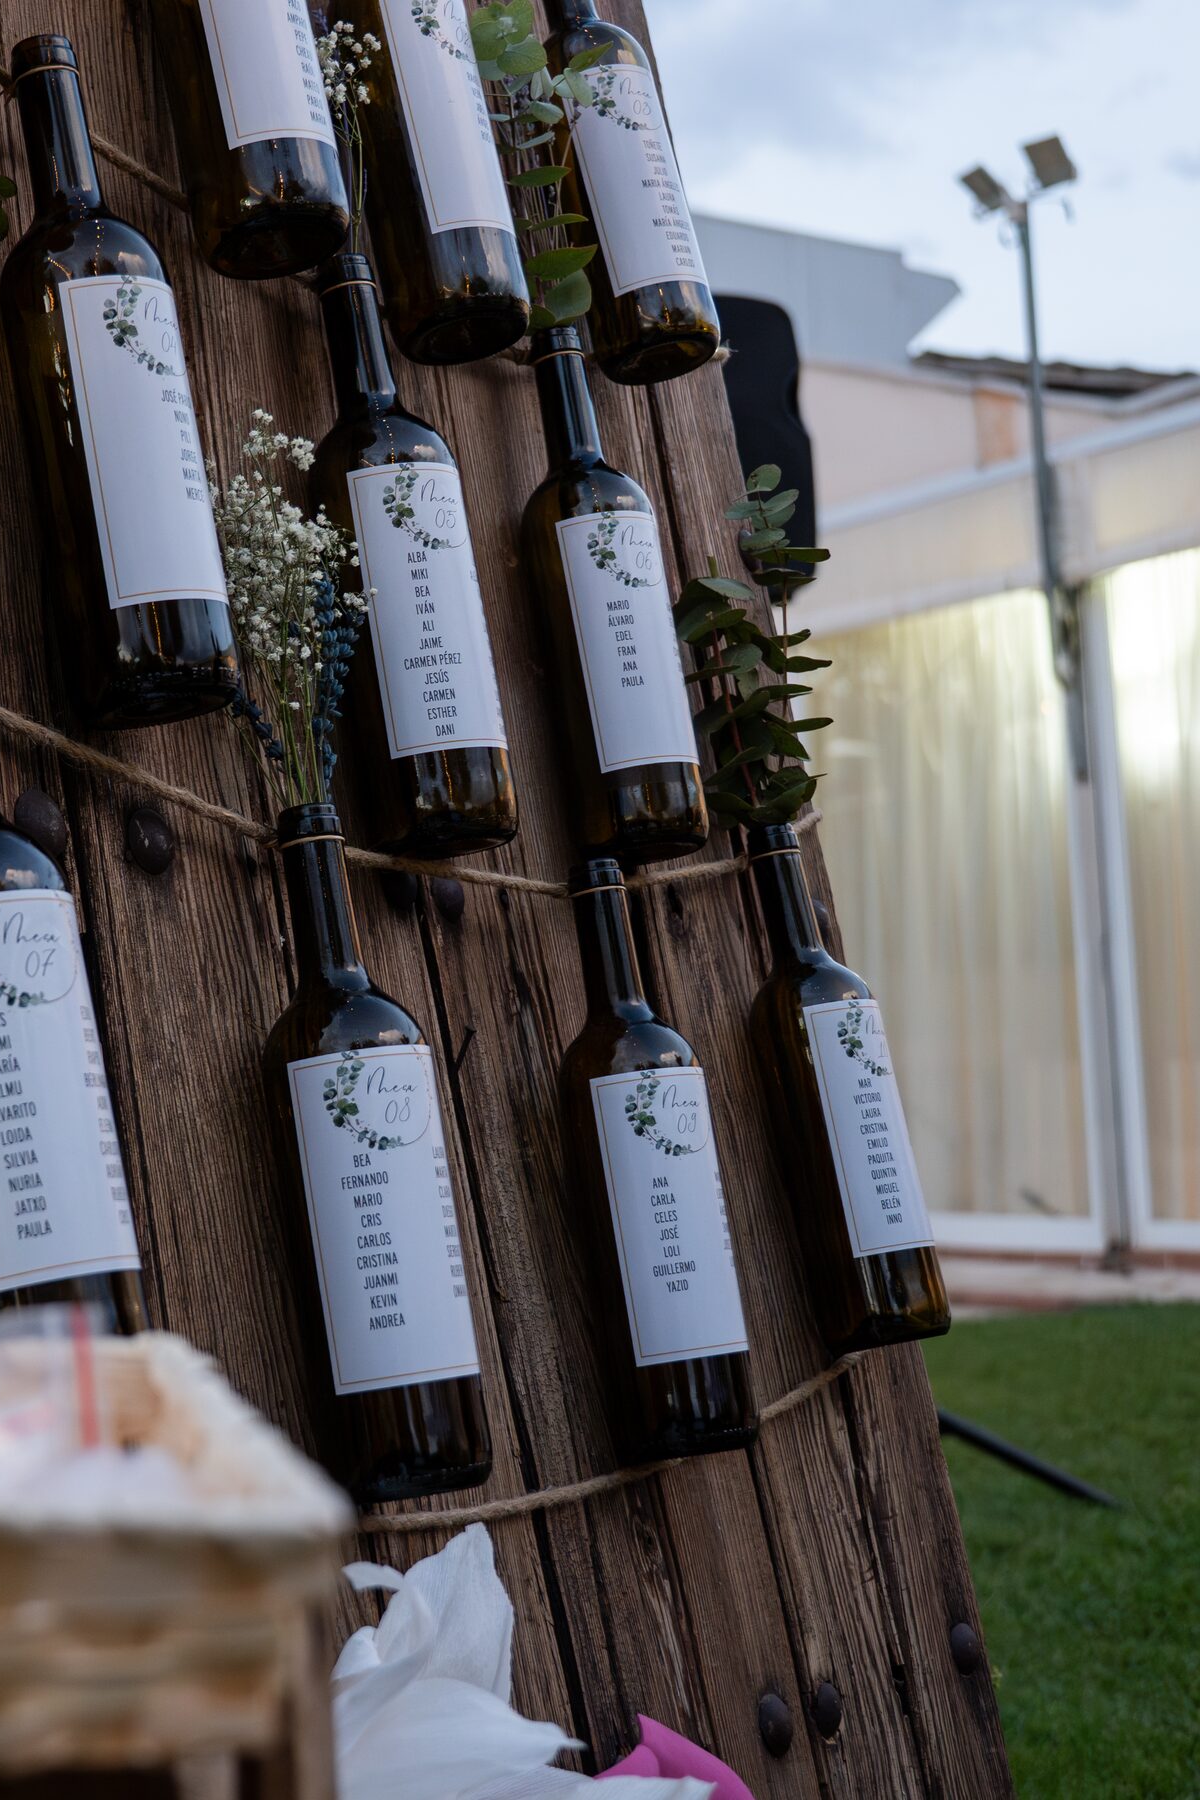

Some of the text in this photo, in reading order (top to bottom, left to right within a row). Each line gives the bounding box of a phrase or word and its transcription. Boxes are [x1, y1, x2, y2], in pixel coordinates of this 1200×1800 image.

[161, 388, 178, 402] JOSÉ
[420, 479, 459, 505] Mesa
[435, 509, 457, 529] 05
[407, 551, 427, 564] ALBA
[635, 551, 652, 570] 06
[411, 568, 428, 580] MIKI
[415, 585, 430, 598] BEA
[416, 601, 435, 615] IVÁN
[606, 600, 630, 612] MARIO
[422, 620, 434, 632] ALI
[608, 614, 634, 628] ÁLVARO
[615, 630, 633, 641] EDEL
[419, 637, 443, 650] JAIME
[617, 644, 637, 657] FRAN
[404, 651, 462, 670] CARMEN PÉREZ
[622, 661, 638, 672] ANA
[424, 669, 449, 685] JESÚS
[621, 676, 644, 688] PAULA
[423, 688, 456, 703] CARMEN
[427, 706, 457, 720] ESTHER
[435, 723, 455, 737] DANI
[2, 911, 60, 945] Mesa
[25, 948, 57, 979] 07
[366, 1066, 418, 1095] Mesa
[858, 1078, 872, 1088] MAR
[662, 1084, 700, 1109] Mesa
[853, 1092, 882, 1105] VICTORIO
[385, 1098, 411, 1124] 08
[861, 1108, 881, 1120] LAURA
[677, 1113, 697, 1134] 09
[860, 1122, 889, 1135] CRISTINA
[0, 1129, 33, 1146] LOIDA
[867, 1137, 889, 1150] EMILIO
[3, 1150, 38, 1170] SILVIA
[353, 1153, 371, 1168] BEA
[868, 1152, 894, 1165] PAQUITA
[8, 1172, 43, 1193] NURIA
[341, 1172, 389, 1190] FERNANDO
[652, 1176, 669, 1189] ANA
[876, 1183, 900, 1195] MIGUEL
[14, 1196, 47, 1217] JATXO
[353, 1191, 383, 1208] MARIO
[650, 1193, 676, 1206] CARLA
[881, 1195, 901, 1210] BELÉN
[360, 1213, 382, 1228] CRIS
[654, 1211, 678, 1224] CELES
[886, 1213, 902, 1225] INNO
[17, 1220, 53, 1240] PAULA
[659, 1225, 680, 1241] JOSÉ
[357, 1232, 392, 1249] CARLOS
[663, 1245, 680, 1258] LOLI
[356, 1251, 398, 1270] CRISTINA
[653, 1261, 696, 1277] GUILLERMO
[364, 1272, 398, 1290] JUANMI
[666, 1278, 689, 1293] YAZID
[370, 1293, 397, 1309] KEVIN
[369, 1312, 405, 1331] ANDREA
